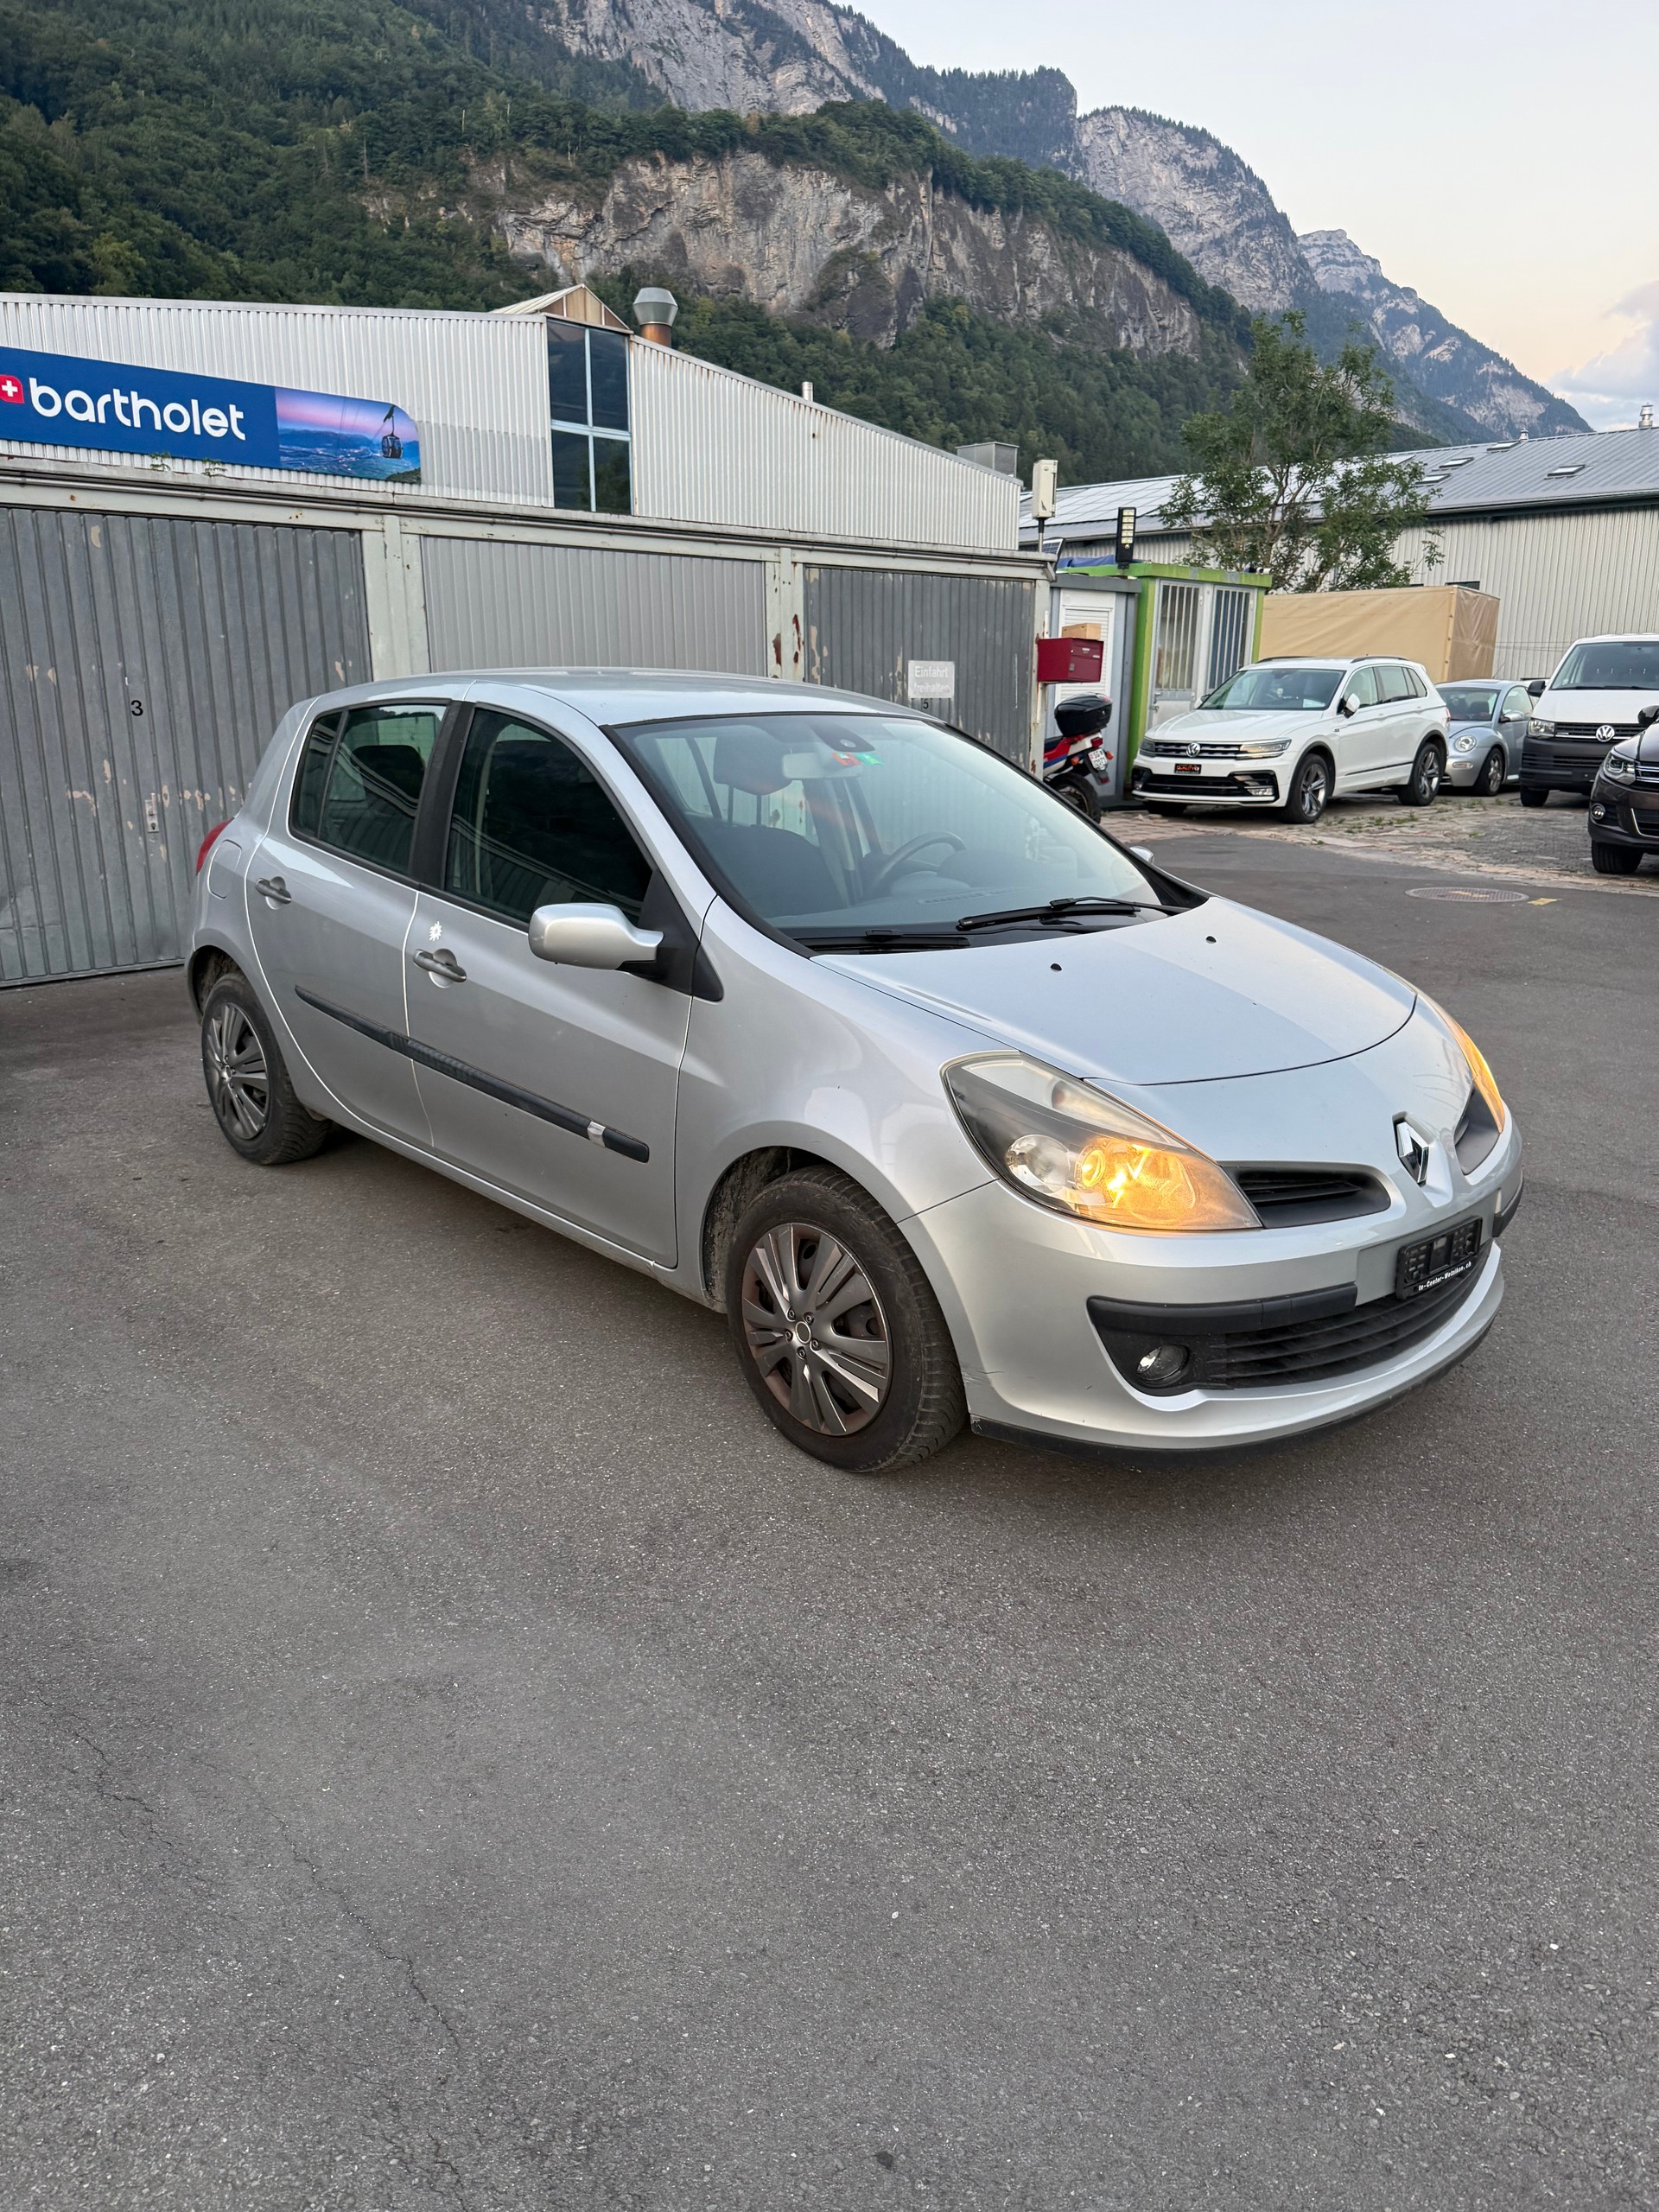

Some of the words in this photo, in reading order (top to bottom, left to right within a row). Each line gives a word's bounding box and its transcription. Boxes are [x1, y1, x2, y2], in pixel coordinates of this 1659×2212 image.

[29, 377, 246, 441] bartholet
[914, 665, 949, 678] Einfahrt
[130, 700, 143, 716] 3
[923, 698, 929, 709] 5
